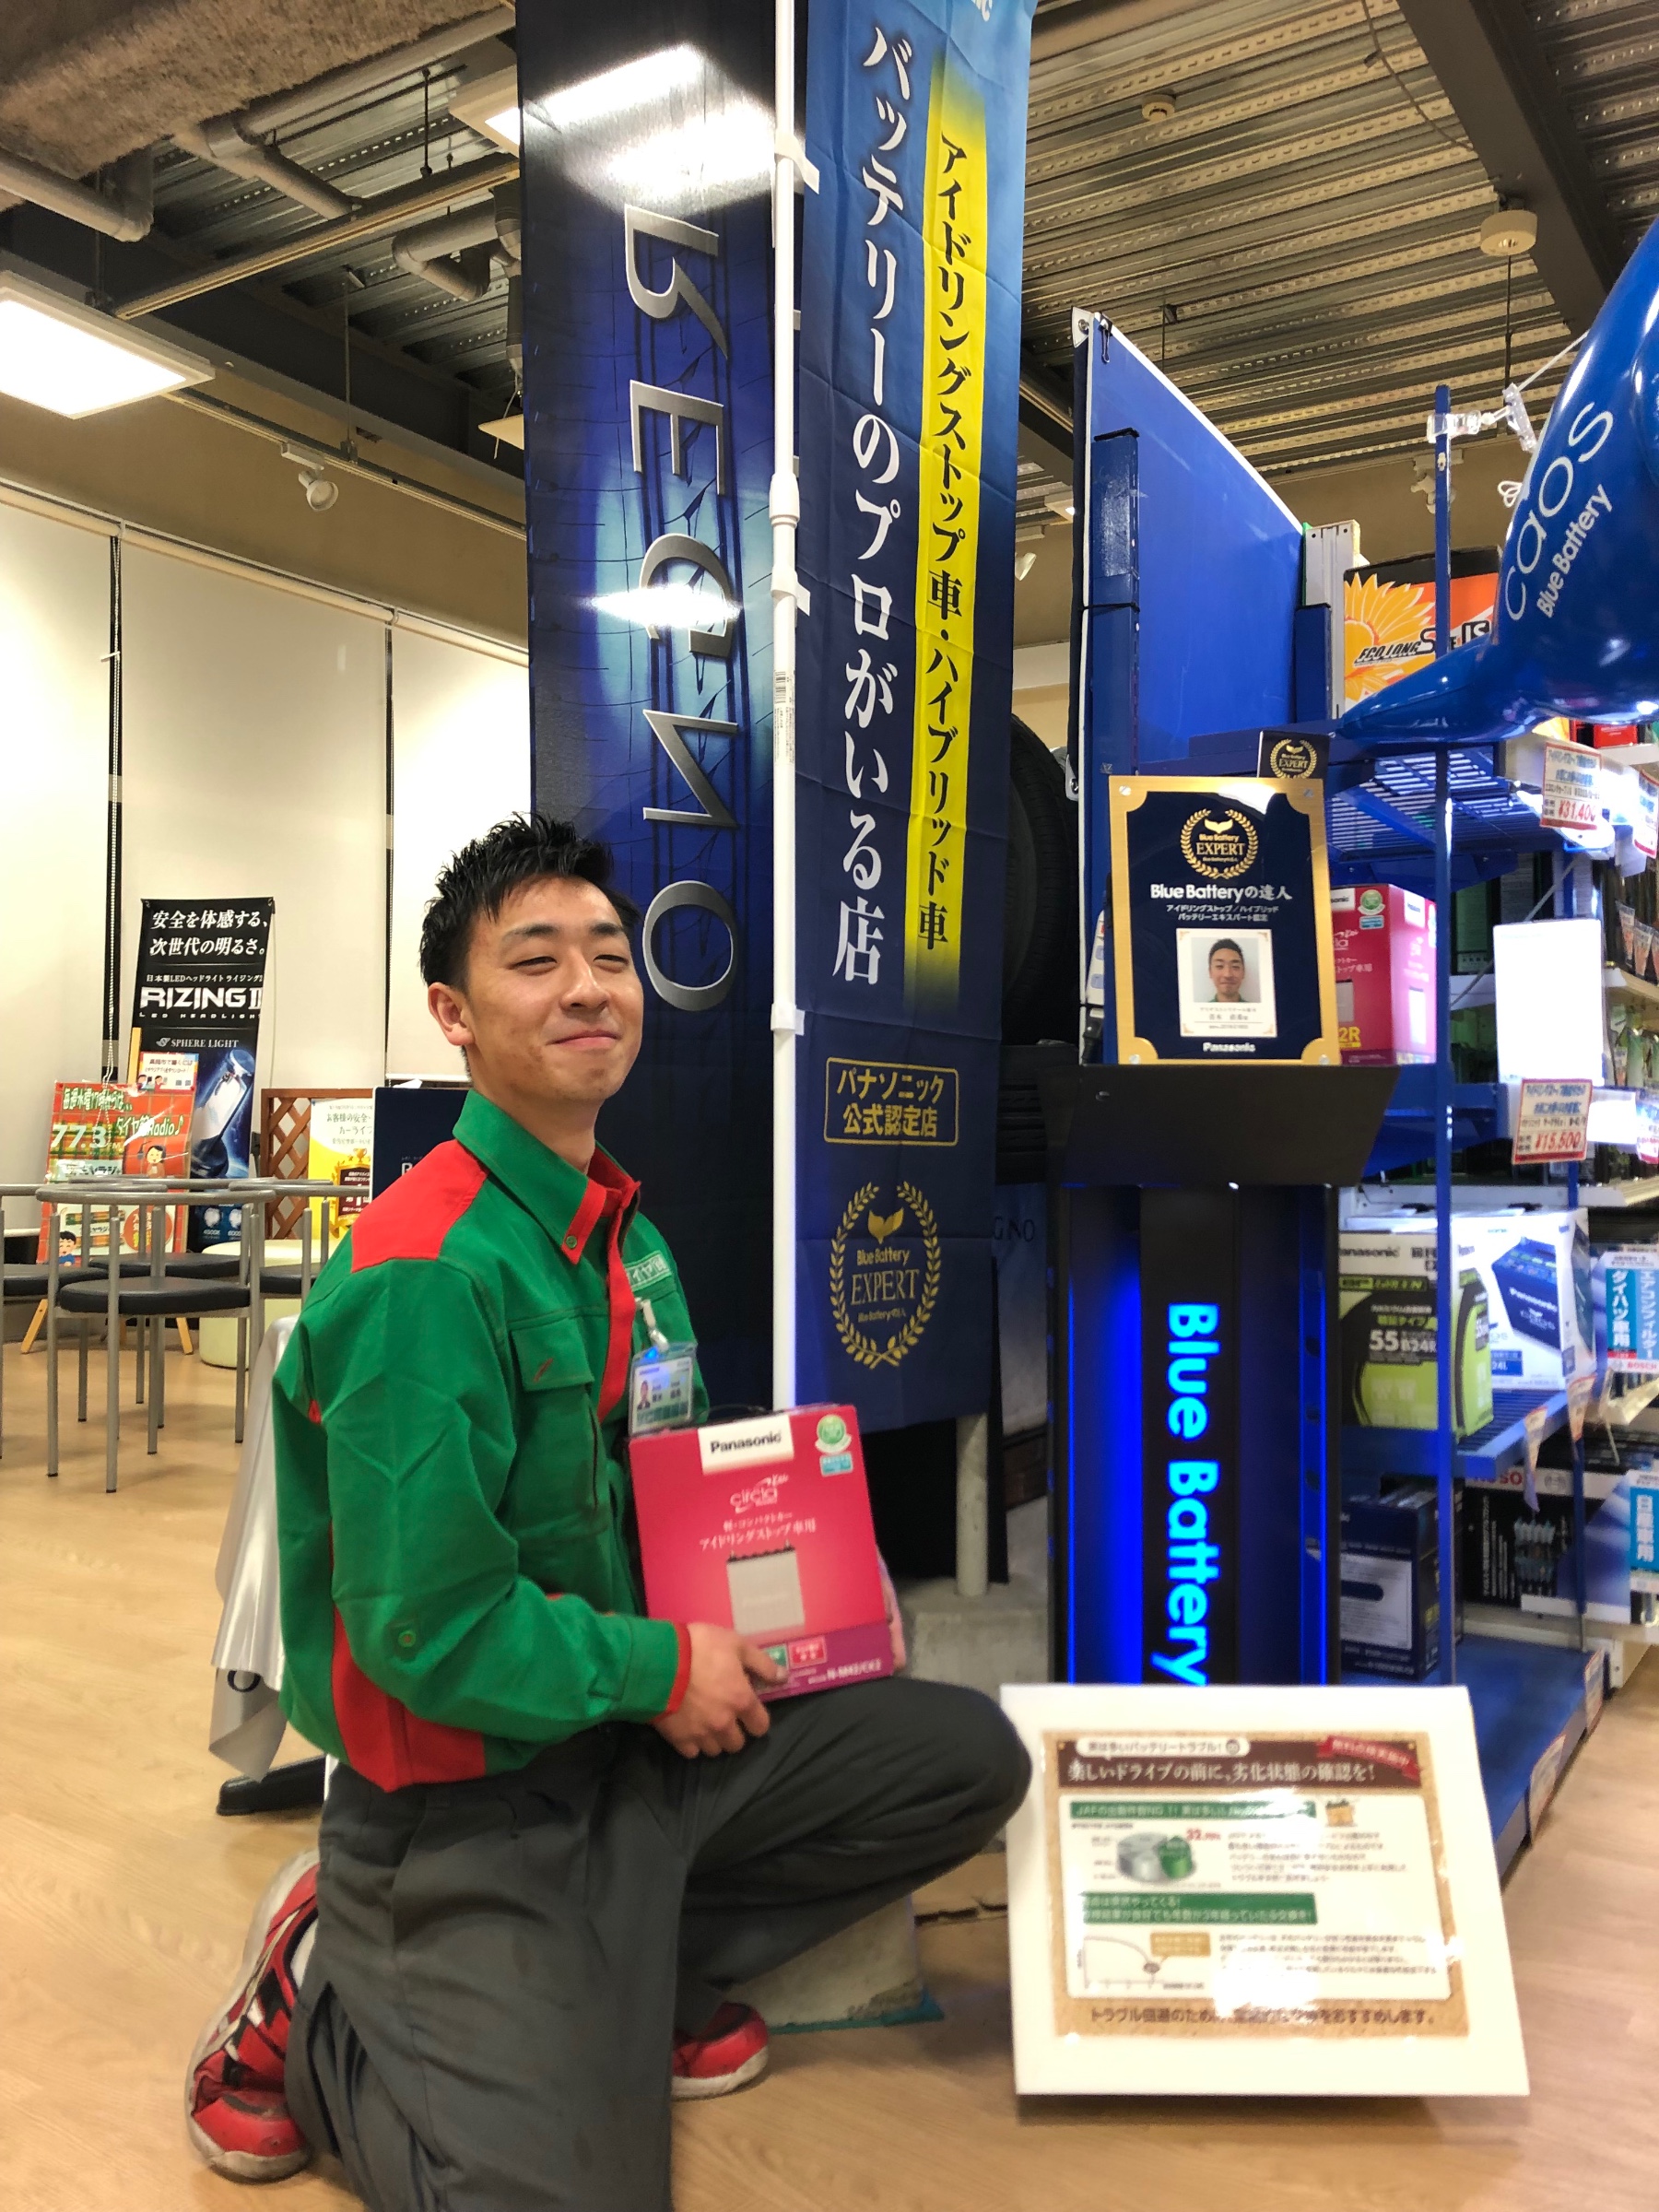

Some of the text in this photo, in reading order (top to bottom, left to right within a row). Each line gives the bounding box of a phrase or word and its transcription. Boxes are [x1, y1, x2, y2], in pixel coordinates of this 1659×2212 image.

[832, 27, 912, 984] バッテリーのプロがいる店
[1505, 402, 1614, 620] caos
[917, 135, 971, 949] アイドリングストップ車・ハイブリッド車
[1537, 484, 1614, 618] Blue Battery
[1195, 841, 1245, 855] EXPERT
[1150, 884, 1184, 900] Blue
[150, 909, 268, 929] 安全を体感する、
[149, 936, 265, 957] 次世代の明るさ。
[139, 986, 247, 1010] RIZING
[171, 1038, 239, 1048] SPHERE LIGHT
[836, 1067, 945, 1104] パナソニック
[842, 1102, 938, 1137] 公式認定店
[51, 1123, 107, 1149] 77.3
[856, 1246, 911, 1266] Blue Battery
[1339, 1246, 1399, 1258] anasonic
[850, 1268, 920, 1306] EXPERT
[1369, 1328, 1399, 1352] 55
[711, 1431, 782, 1453] Panasonic
[1150, 1303, 1220, 1686] Blue Battery
